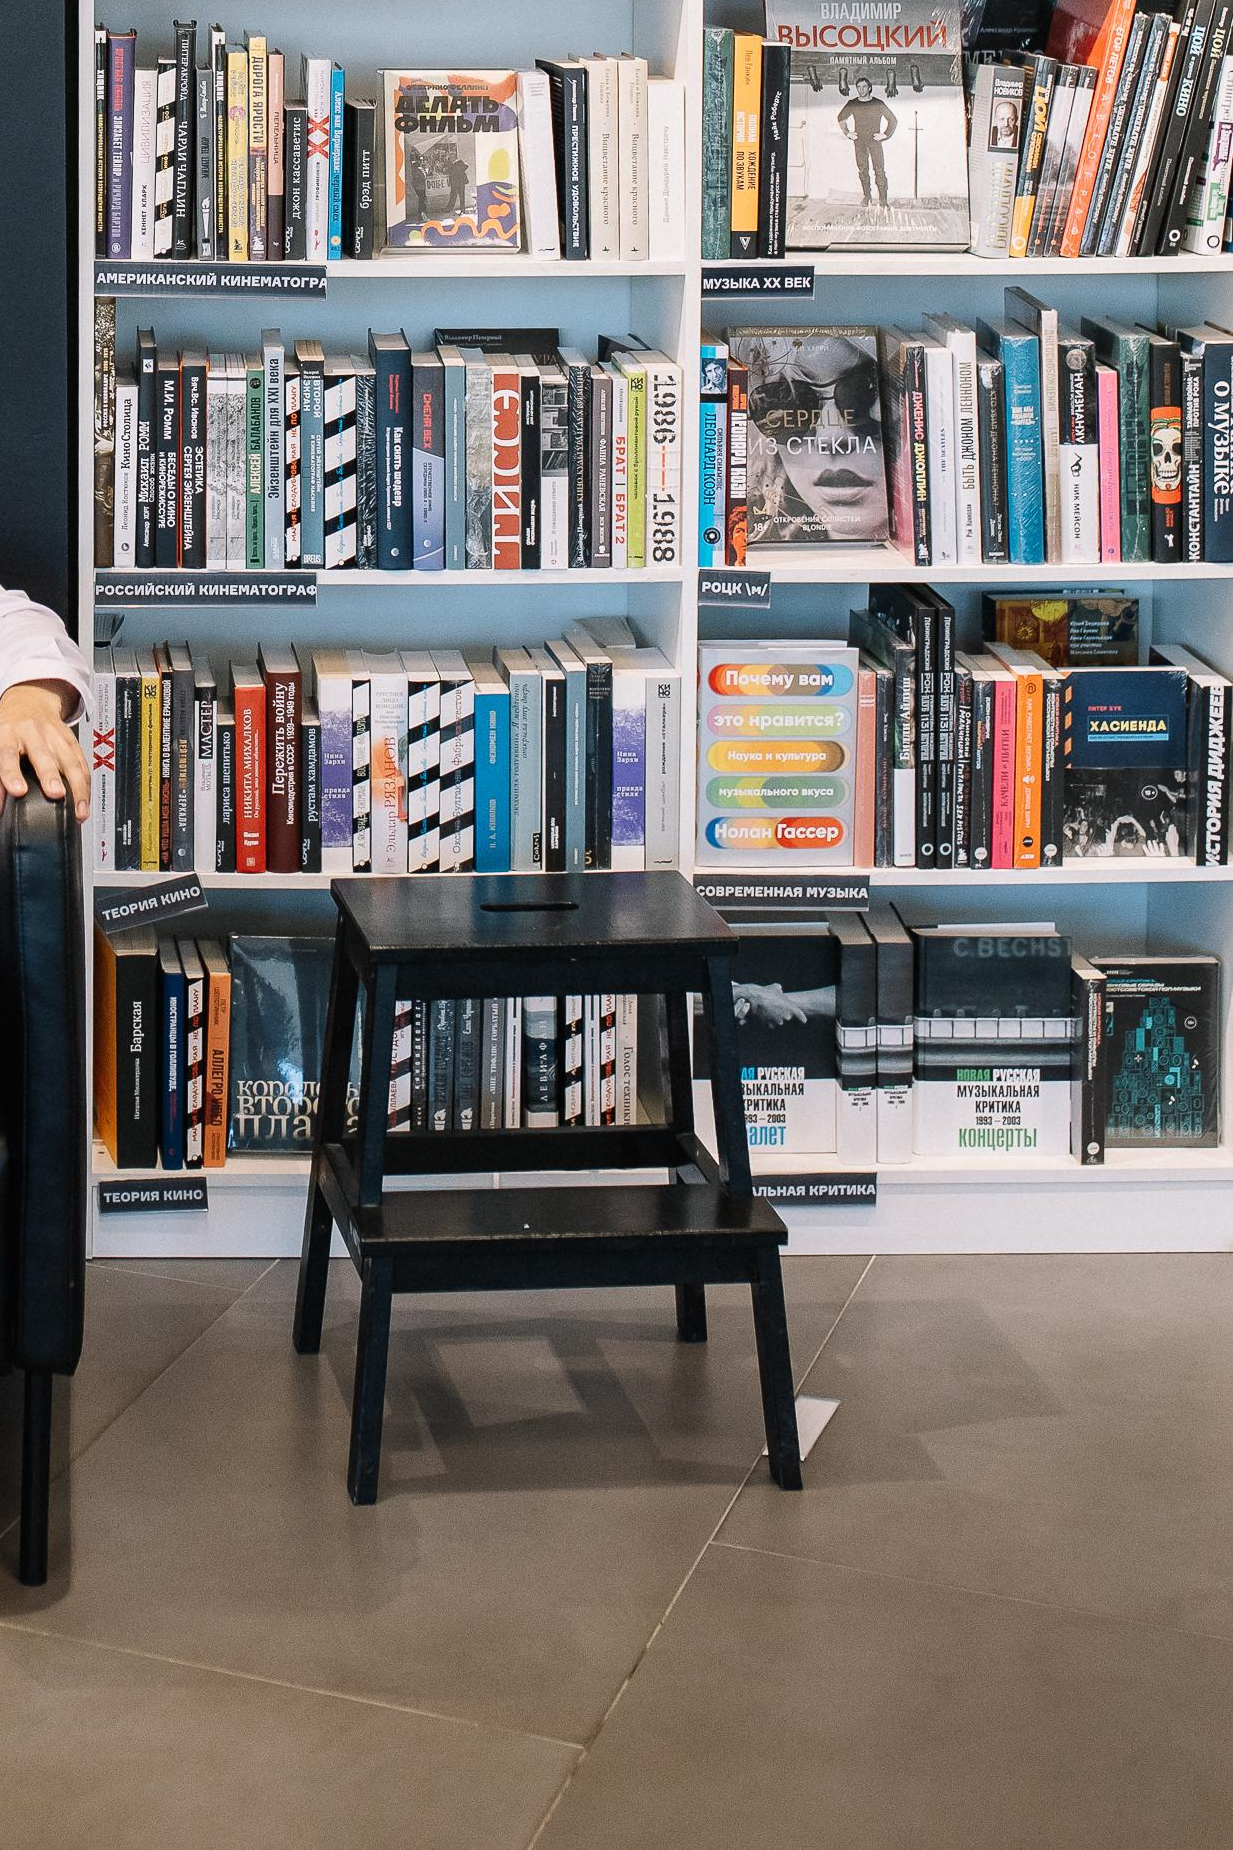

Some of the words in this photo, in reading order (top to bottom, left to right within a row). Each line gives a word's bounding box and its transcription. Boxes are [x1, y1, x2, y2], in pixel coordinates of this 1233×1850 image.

[821, 2, 901, 20] ВЛАДИМИР
[777, 21, 947, 51] ВЫСОЦКИЙ
[829, 56, 868, 65] ПАМЯТНЫЙ
[869, 57, 897, 65] АЛЬБОМ
[395, 95, 500, 113] ДЕЛАТЬ
[142, 81, 152, 164] ЦИВИЛИЗАЦИЯ
[395, 115, 500, 133] ФИЛЬМ
[178, 121, 187, 160] ЧАРЛИ
[292, 117, 301, 183] кассаветис
[362, 150, 370, 177] питт
[176, 164, 186, 217] ЧАПЛИН
[292, 188, 302, 219] джон
[360, 182, 371, 208] брэд
[572, 185, 580, 248] УДОВОЛЬСТВИЕ
[96, 272, 217, 286] АМЕРИКАНСКИЙ
[703, 277, 759, 290] МУЗЫКА
[785, 277, 811, 288] ВЕК
[269, 358, 278, 383] века
[268, 387, 278, 404] XXI
[959, 362, 973, 414] ЛЕННОНОМ
[250, 397, 261, 450] БАЛАБАНОВ
[269, 408, 281, 426] для
[652, 375, 676, 444] 1986
[765, 409, 854, 430] СЕРДЦЕ
[704, 412, 717, 468] ЛЕОНАРД
[730, 412, 747, 468] ЛЕОНАРД
[747, 438, 778, 455] ИЗ
[786, 437, 877, 455] СТЕКЛА
[961, 417, 976, 460] ДЖОНОМ
[267, 430, 280, 498] Эйзенштейн
[615, 436, 625, 475] БРАТ
[250, 454, 261, 494] АЛЕКСЕЙ
[493, 389, 520, 555] ТИССЭ
[730, 472, 747, 500] КОЭН
[962, 464, 975, 490] БЫТЬ
[703, 471, 716, 506] КОЭН
[615, 493, 625, 532] БРАТ
[652, 493, 676, 562] 1988
[1188, 464, 1201, 562] КОНСТАНТАЙН
[95, 582, 195, 596] РОССИЙСКИЙ
[199, 584, 317, 597] КИНЕМАТОГРАФ
[701, 581, 742, 595] РОЦК
[726, 670, 794, 689] Почему
[799, 673, 833, 686] вам
[275, 682, 288, 724] войну
[202, 701, 213, 758] МАСТЕР
[714, 714, 744, 725] это
[750, 712, 845, 730] нравится?
[1089, 720, 1167, 733] ХАСИЕНДА
[244, 708, 252, 767] МИХАЛКОВ
[222, 731, 231, 785] шепитько
[272, 727, 286, 795] Пережить
[308, 728, 316, 780] хамдамов
[728, 751, 763, 762] Наука
[766, 753, 772, 761] и
[775, 752, 826, 763] культура
[384, 737, 397, 807] РЯЗАНОВ
[222, 788, 231, 825] лариса
[244, 770, 252, 819] НИКИТА
[308, 782, 316, 822] рустам
[719, 787, 799, 798] музыкального
[802, 787, 834, 797] вкуса
[386, 809, 397, 852] Эльдар
[715, 824, 772, 839] Нолан
[777, 823, 839, 842] Гассер
[1205, 778, 1222, 867] ИСТОРИЯ
[102, 897, 159, 922] ТЕОРИЯ
[160, 886, 201, 906] КИНО
[696, 885, 803, 898] СОВРЕМЕННАЯ
[806, 886, 868, 899] МУЗЫКА
[130, 1000, 143, 1053] Барская
[757, 1067, 805, 1081] РУССКАЯ
[957, 1069, 990, 1081] НОВАЯ
[993, 1069, 1040, 1081] РУССКАЯ
[741, 1083, 804, 1096] ЗЫКАЛЬНАЯ
[957, 1085, 1040, 1098] МУЗЫКАЛЬНАЯ
[975, 1100, 1021, 1114] КРИТИКА
[975, 1116, 993, 1125] 1993
[1002, 1116, 1021, 1125] 2003
[749, 1125, 785, 1145] алет
[959, 1127, 1037, 1151] концерты
[103, 1190, 160, 1203] ТЕОРИЯ
[163, 1189, 204, 1201] КИНО
[809, 1184, 877, 1197] КРИТИКА
